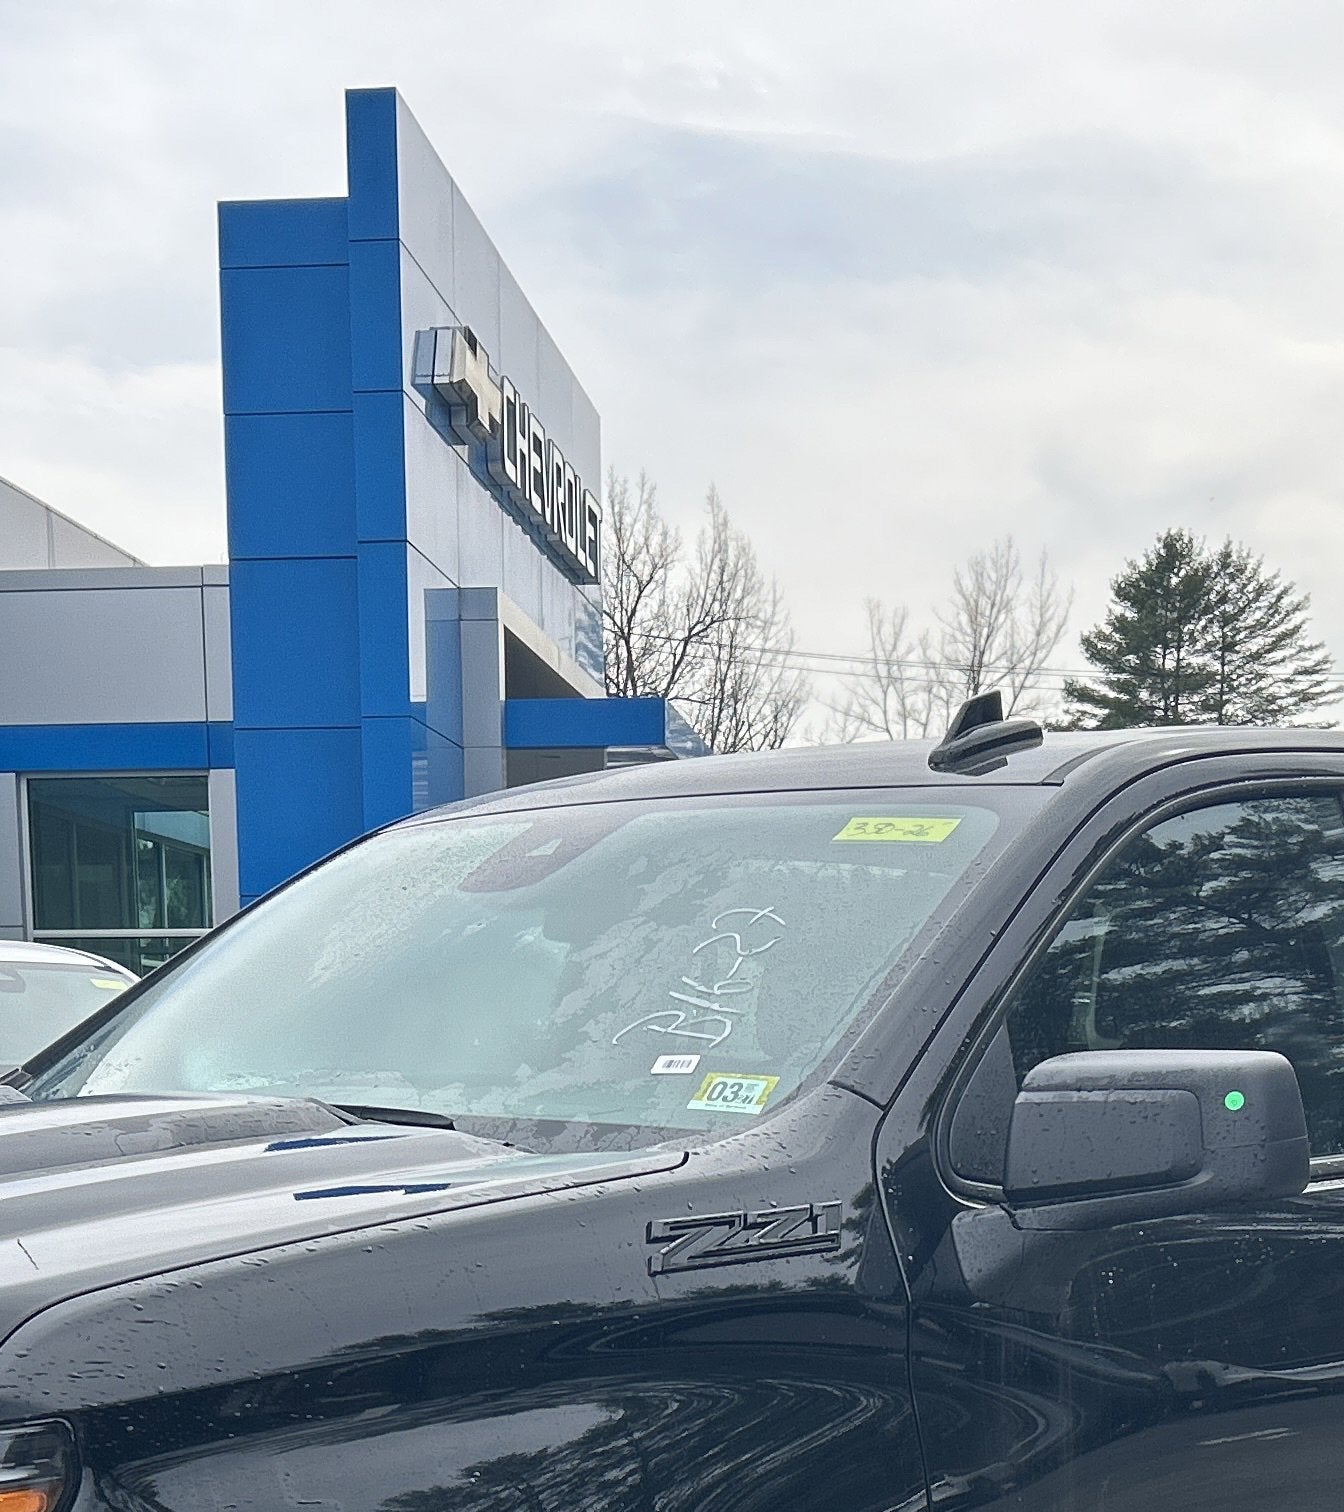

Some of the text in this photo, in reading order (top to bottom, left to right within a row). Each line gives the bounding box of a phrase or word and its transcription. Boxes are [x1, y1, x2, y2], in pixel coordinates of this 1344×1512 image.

[501, 375, 603, 582] CHEVROLET
[706, 1081, 744, 1103] 03
[645, 1199, 843, 1277] Z71
